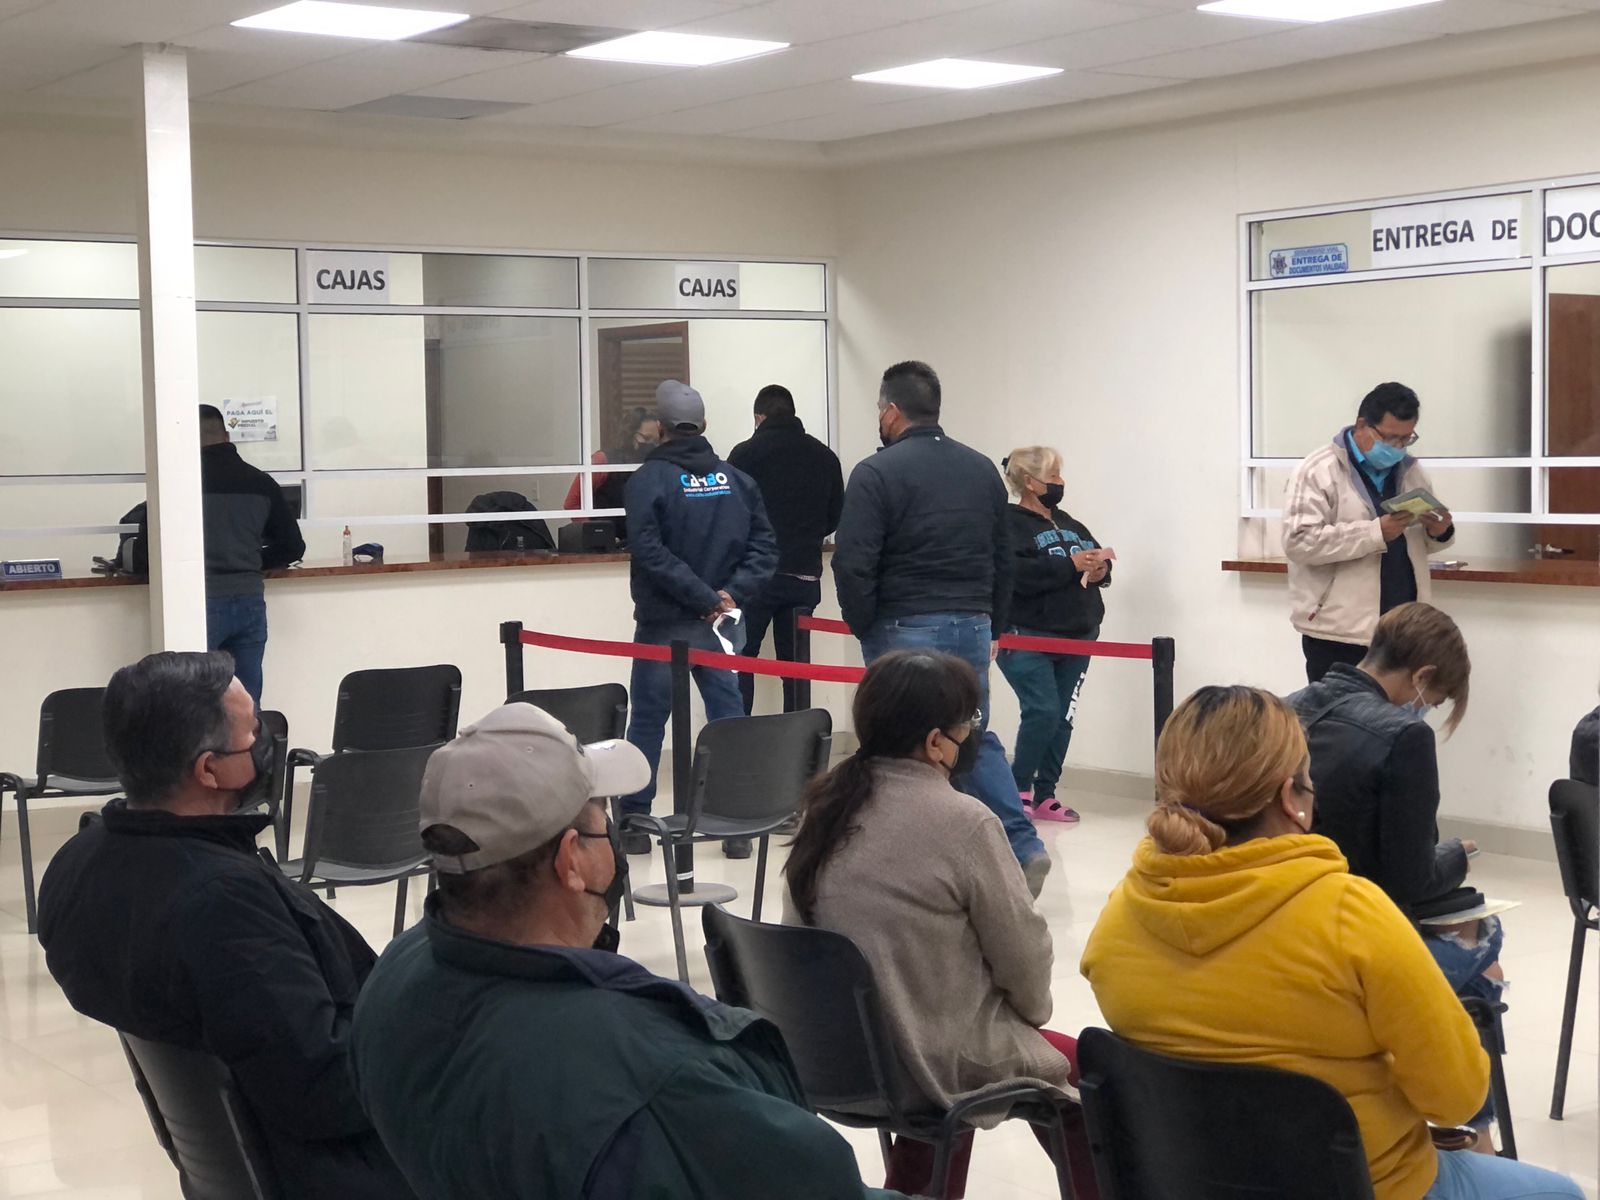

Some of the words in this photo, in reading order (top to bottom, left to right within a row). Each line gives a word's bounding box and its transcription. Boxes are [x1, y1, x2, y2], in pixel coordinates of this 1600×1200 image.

[1372, 219, 1475, 253] ENTREGA
[1491, 218, 1518, 241] DE
[1291, 254, 1330, 266] ENTREGA
[1331, 253, 1343, 262] DE
[1288, 264, 1322, 275] DOCUMENTOS
[316, 268, 386, 291] CAJAS
[679, 277, 737, 298] CAJAS
[9, 563, 55, 574] ABIERTO
